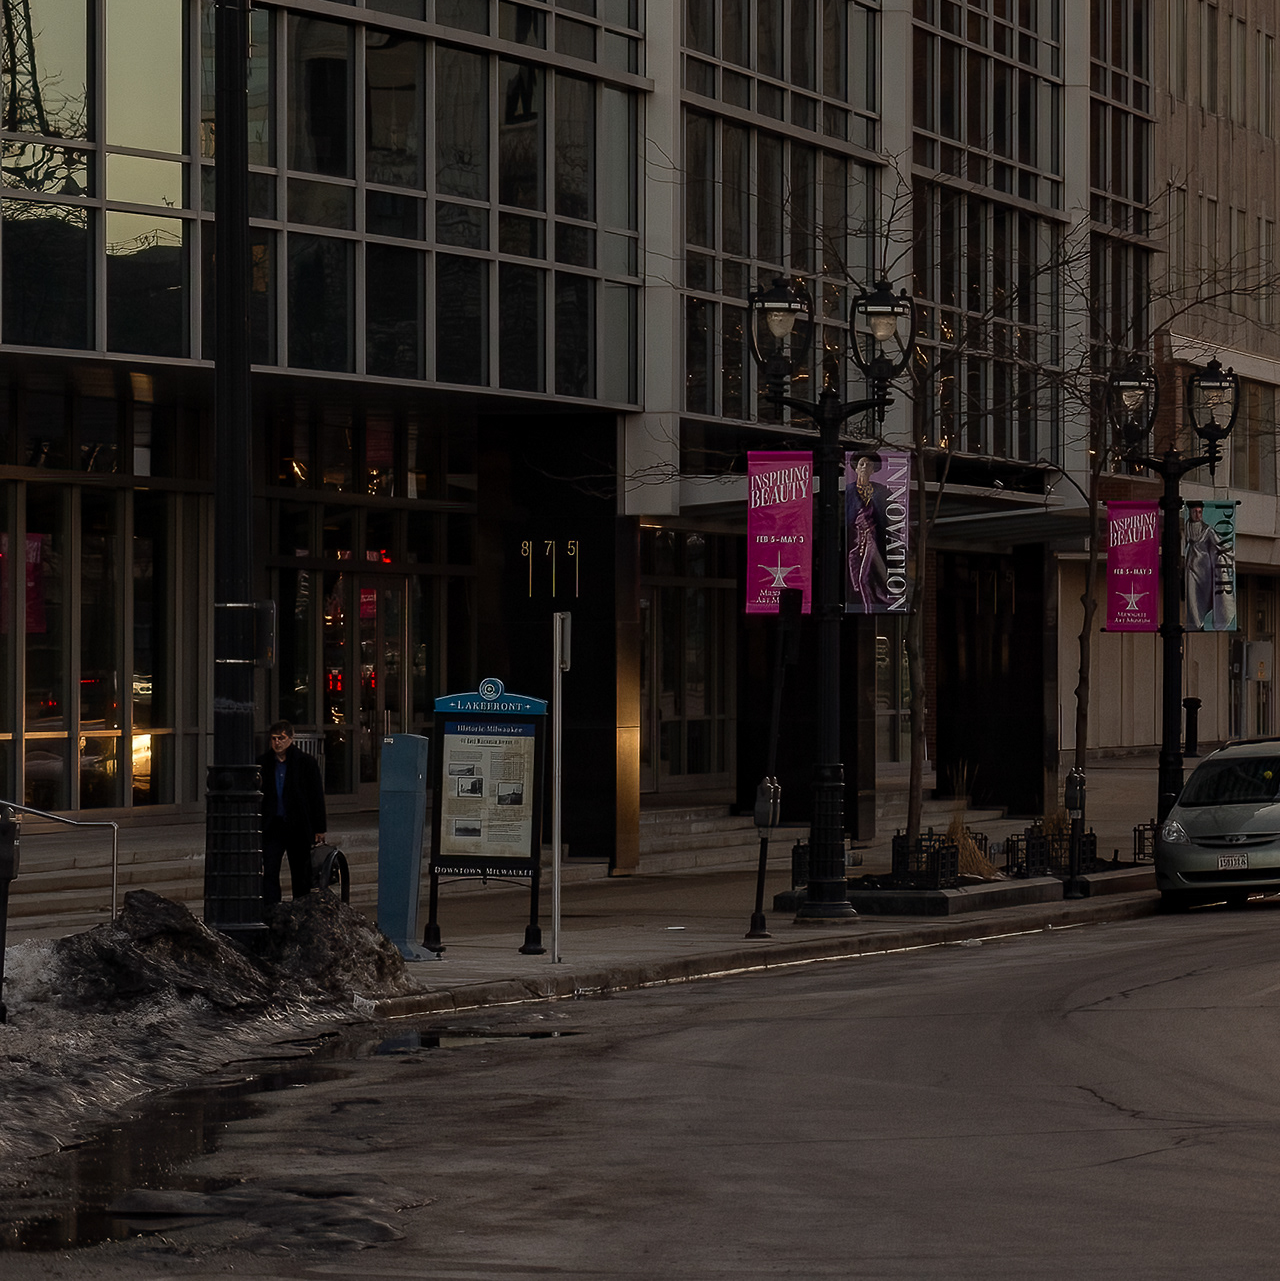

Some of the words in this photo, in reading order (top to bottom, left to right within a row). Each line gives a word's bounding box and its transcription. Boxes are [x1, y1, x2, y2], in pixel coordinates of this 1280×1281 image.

[750, 465, 810, 491] INSPIRING
[750, 479, 810, 509] BEAUTY
[885, 457, 908, 613] INNOVATION
[1109, 512, 1157, 533] INSPIRING
[756, 535, 768, 543] FEB
[1109, 523, 1156, 548] BEAUTY
[1214, 504, 1234, 595] POWER
[457, 700, 522, 711] LAKEFRONT
[434, 866, 482, 874] DOWNTOWN
[486, 867, 534, 876] MILWAUKEE
